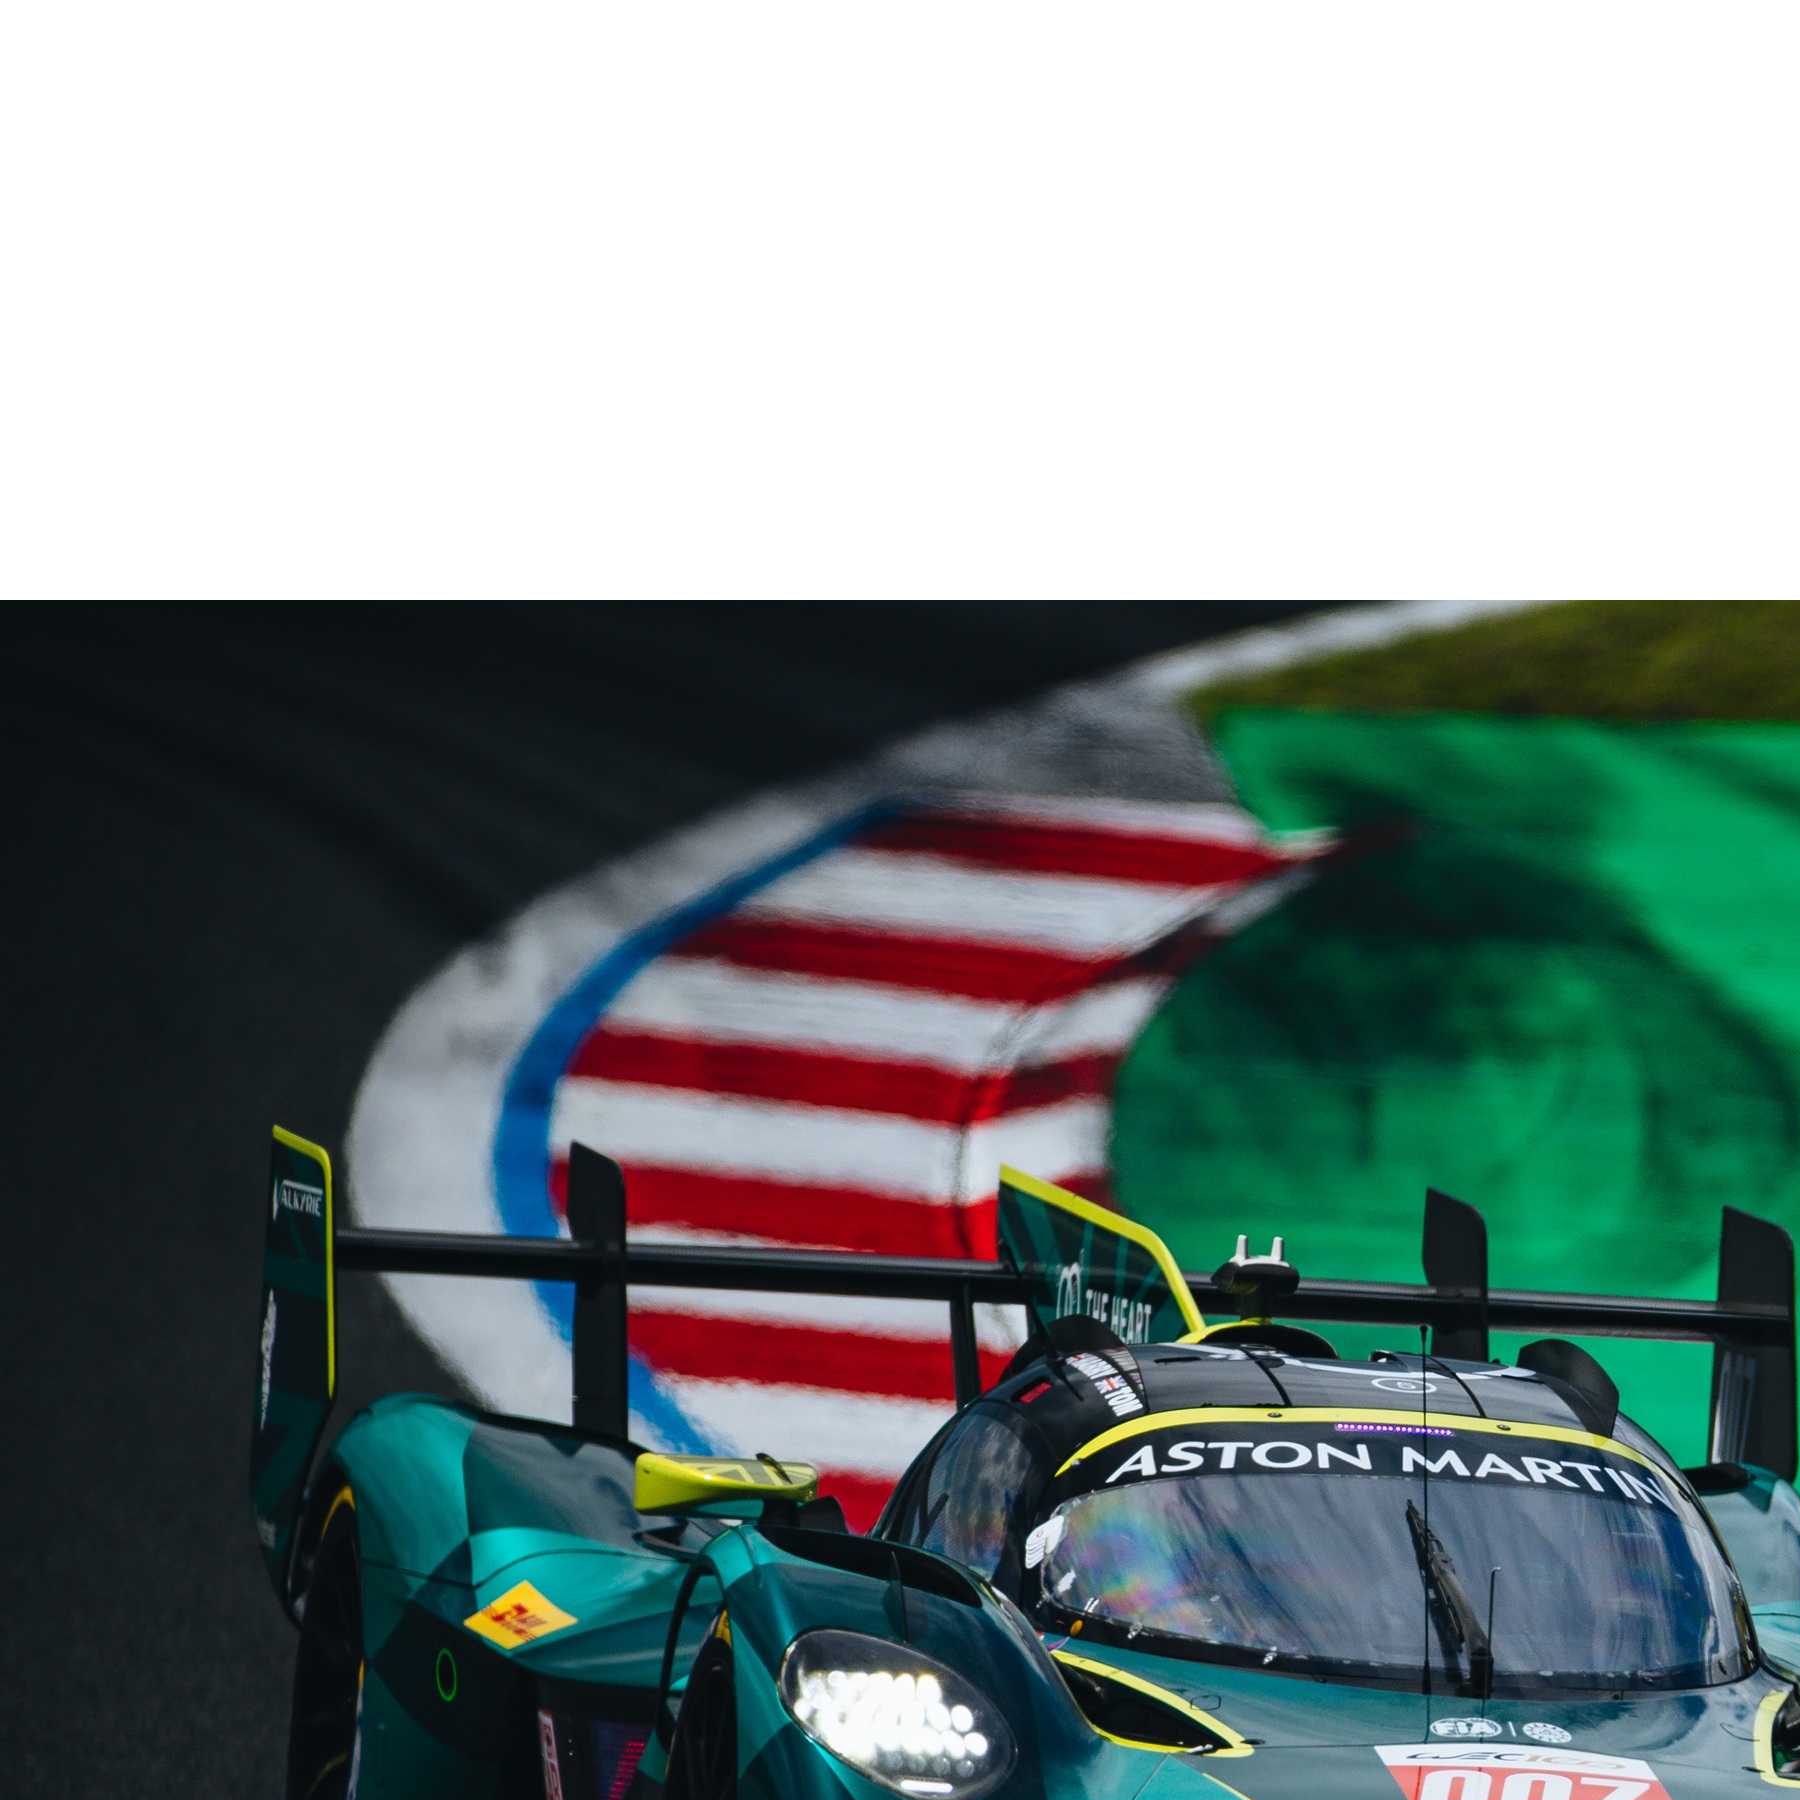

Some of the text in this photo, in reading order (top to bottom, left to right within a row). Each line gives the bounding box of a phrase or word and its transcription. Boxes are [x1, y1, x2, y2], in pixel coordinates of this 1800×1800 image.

[1111, 1295, 1152, 1345] HEART
[1105, 1441, 1682, 1517] ASTON MARTIN
[1432, 1718, 1499, 1737] FIA
